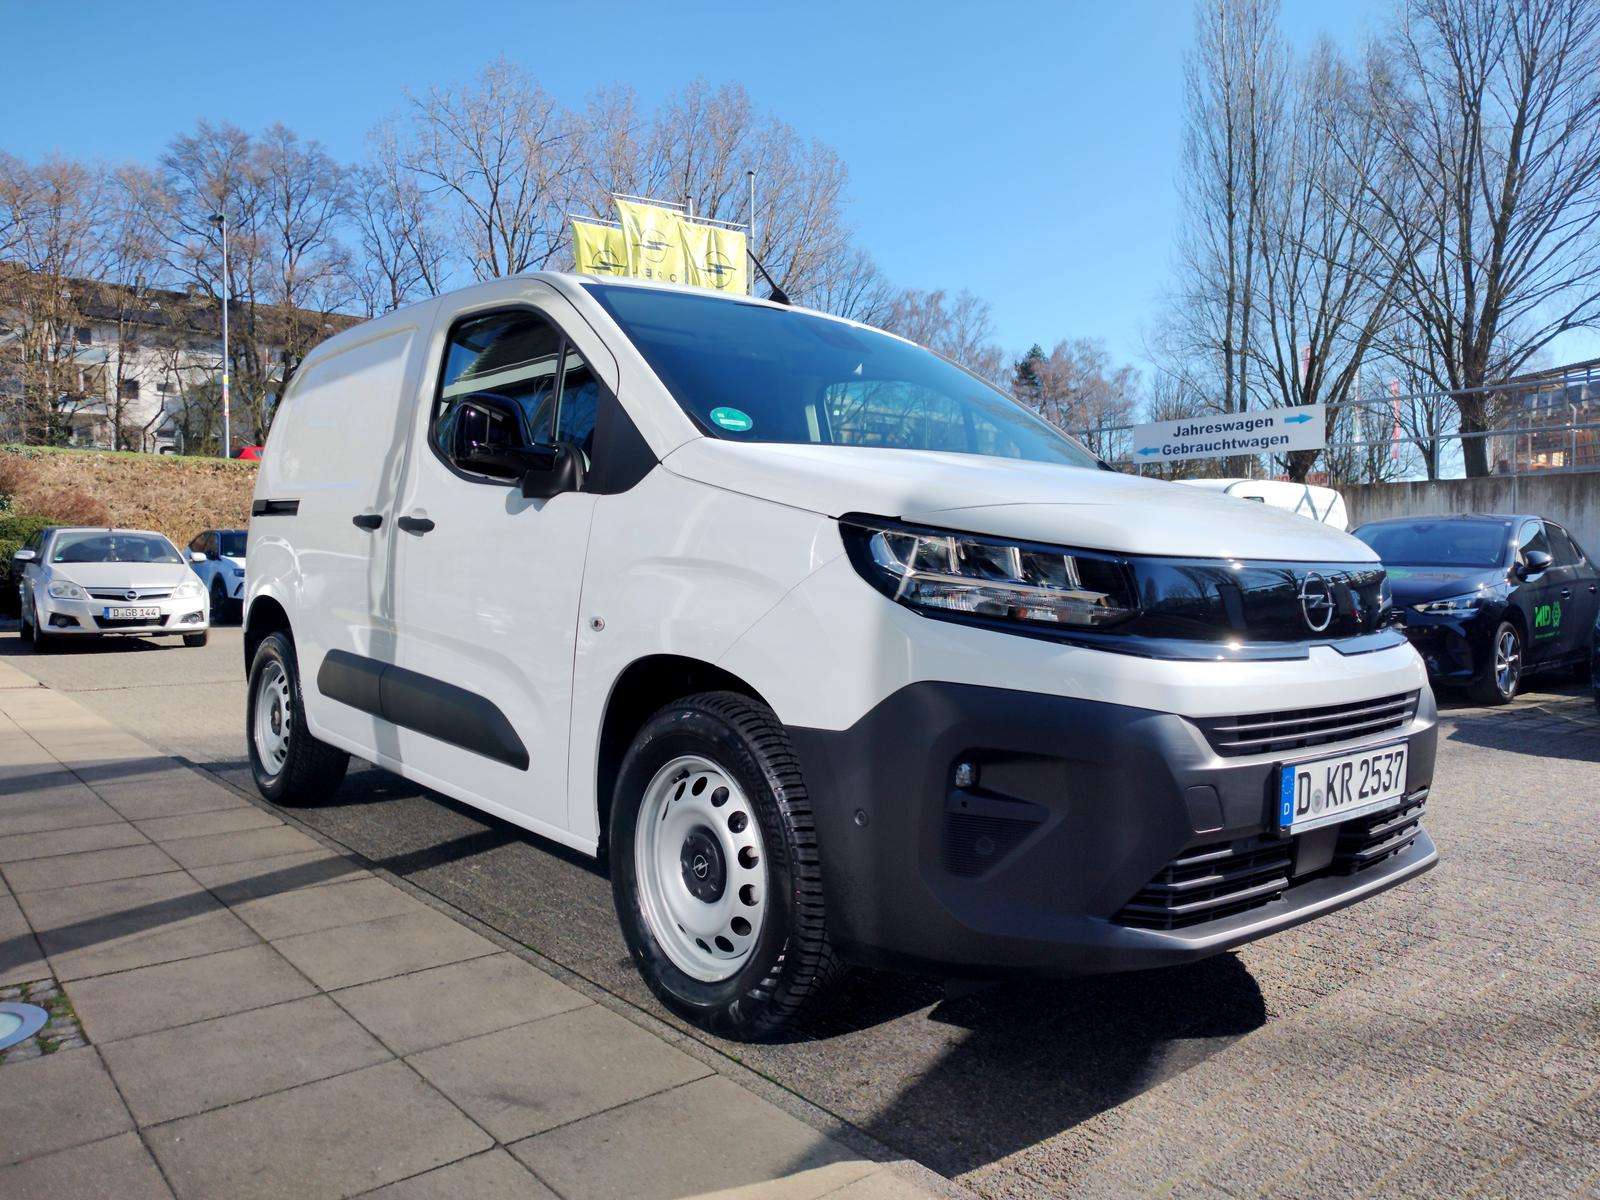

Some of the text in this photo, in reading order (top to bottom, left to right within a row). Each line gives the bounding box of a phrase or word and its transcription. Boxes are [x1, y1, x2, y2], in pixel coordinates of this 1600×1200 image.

[1172, 416, 1274, 438] Jahreswagen
[1162, 434, 1289, 456] Gebrauchtwagen
[139, 608, 156, 617] 144
[1296, 750, 1404, 816] D KR 2537
[1283, 802, 1290, 816] D
